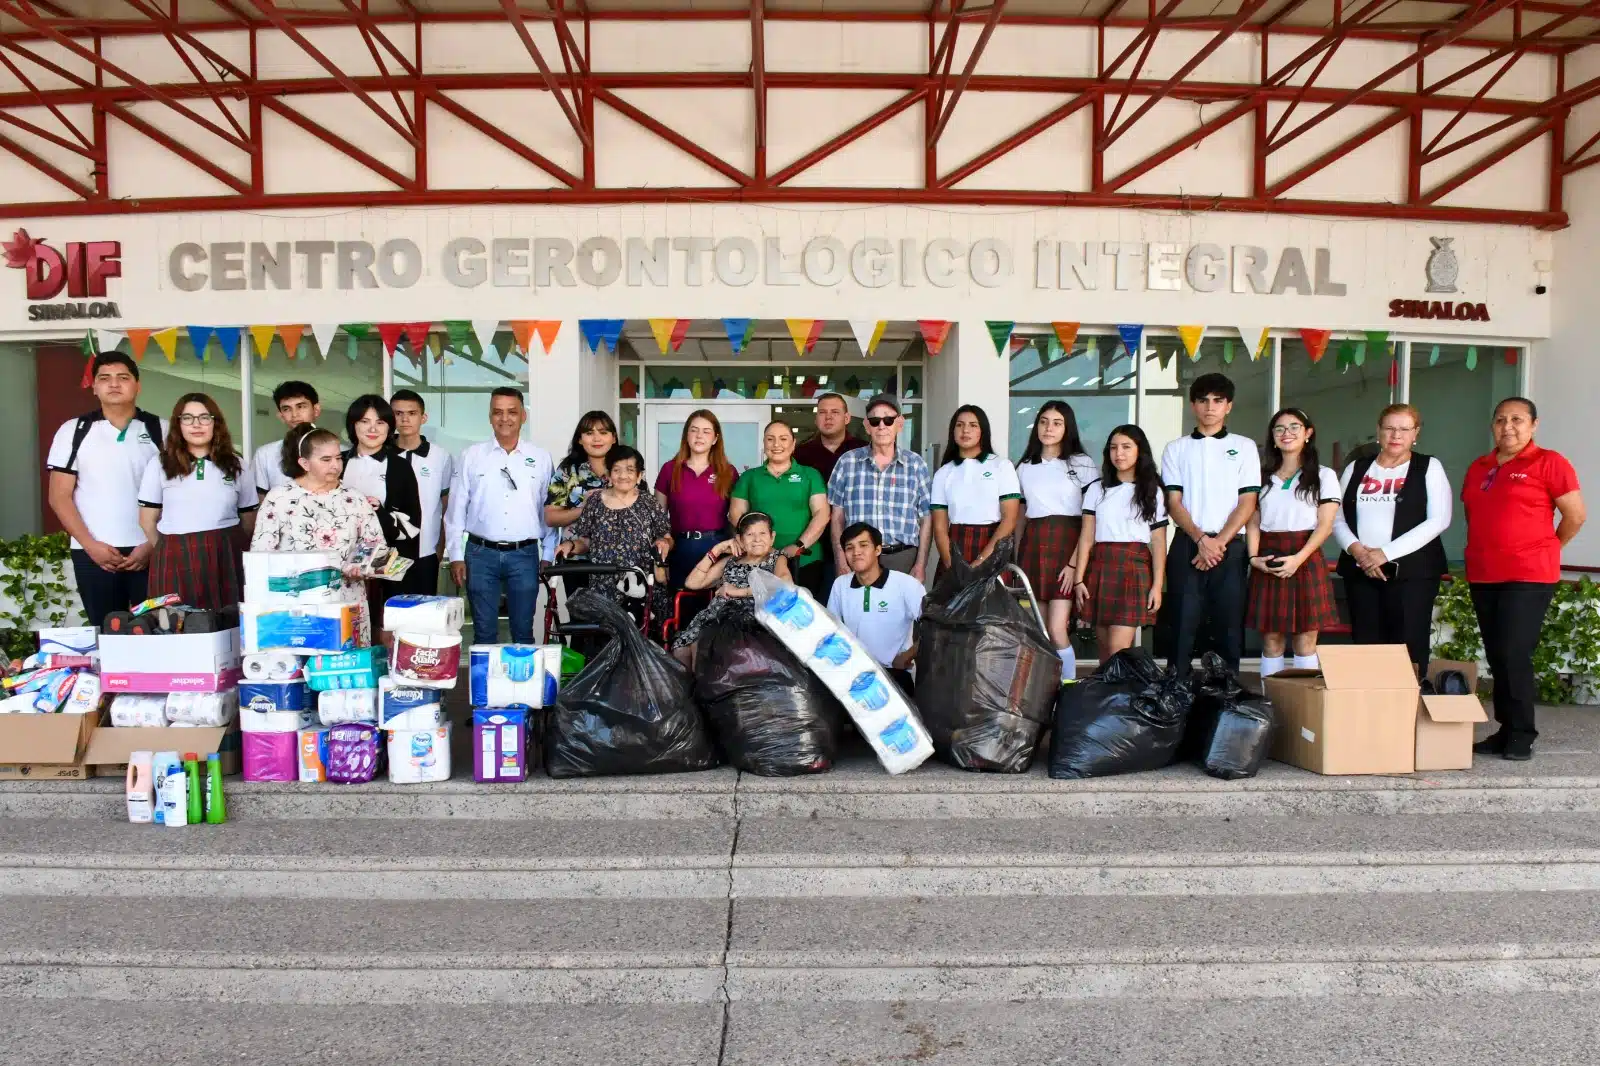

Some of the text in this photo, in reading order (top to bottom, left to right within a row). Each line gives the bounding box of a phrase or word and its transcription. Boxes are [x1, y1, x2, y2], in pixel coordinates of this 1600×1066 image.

[24, 241, 122, 301] DIF
[168, 235, 1347, 297] CENTRO GERONTOLOGICO INTEGRAL
[28, 302, 122, 321] SINALOA
[1388, 298, 1491, 322] SINALOA
[1361, 477, 1407, 494] DIF
[410, 655, 441, 667] Quality
[415, 648, 439, 658] Facial
